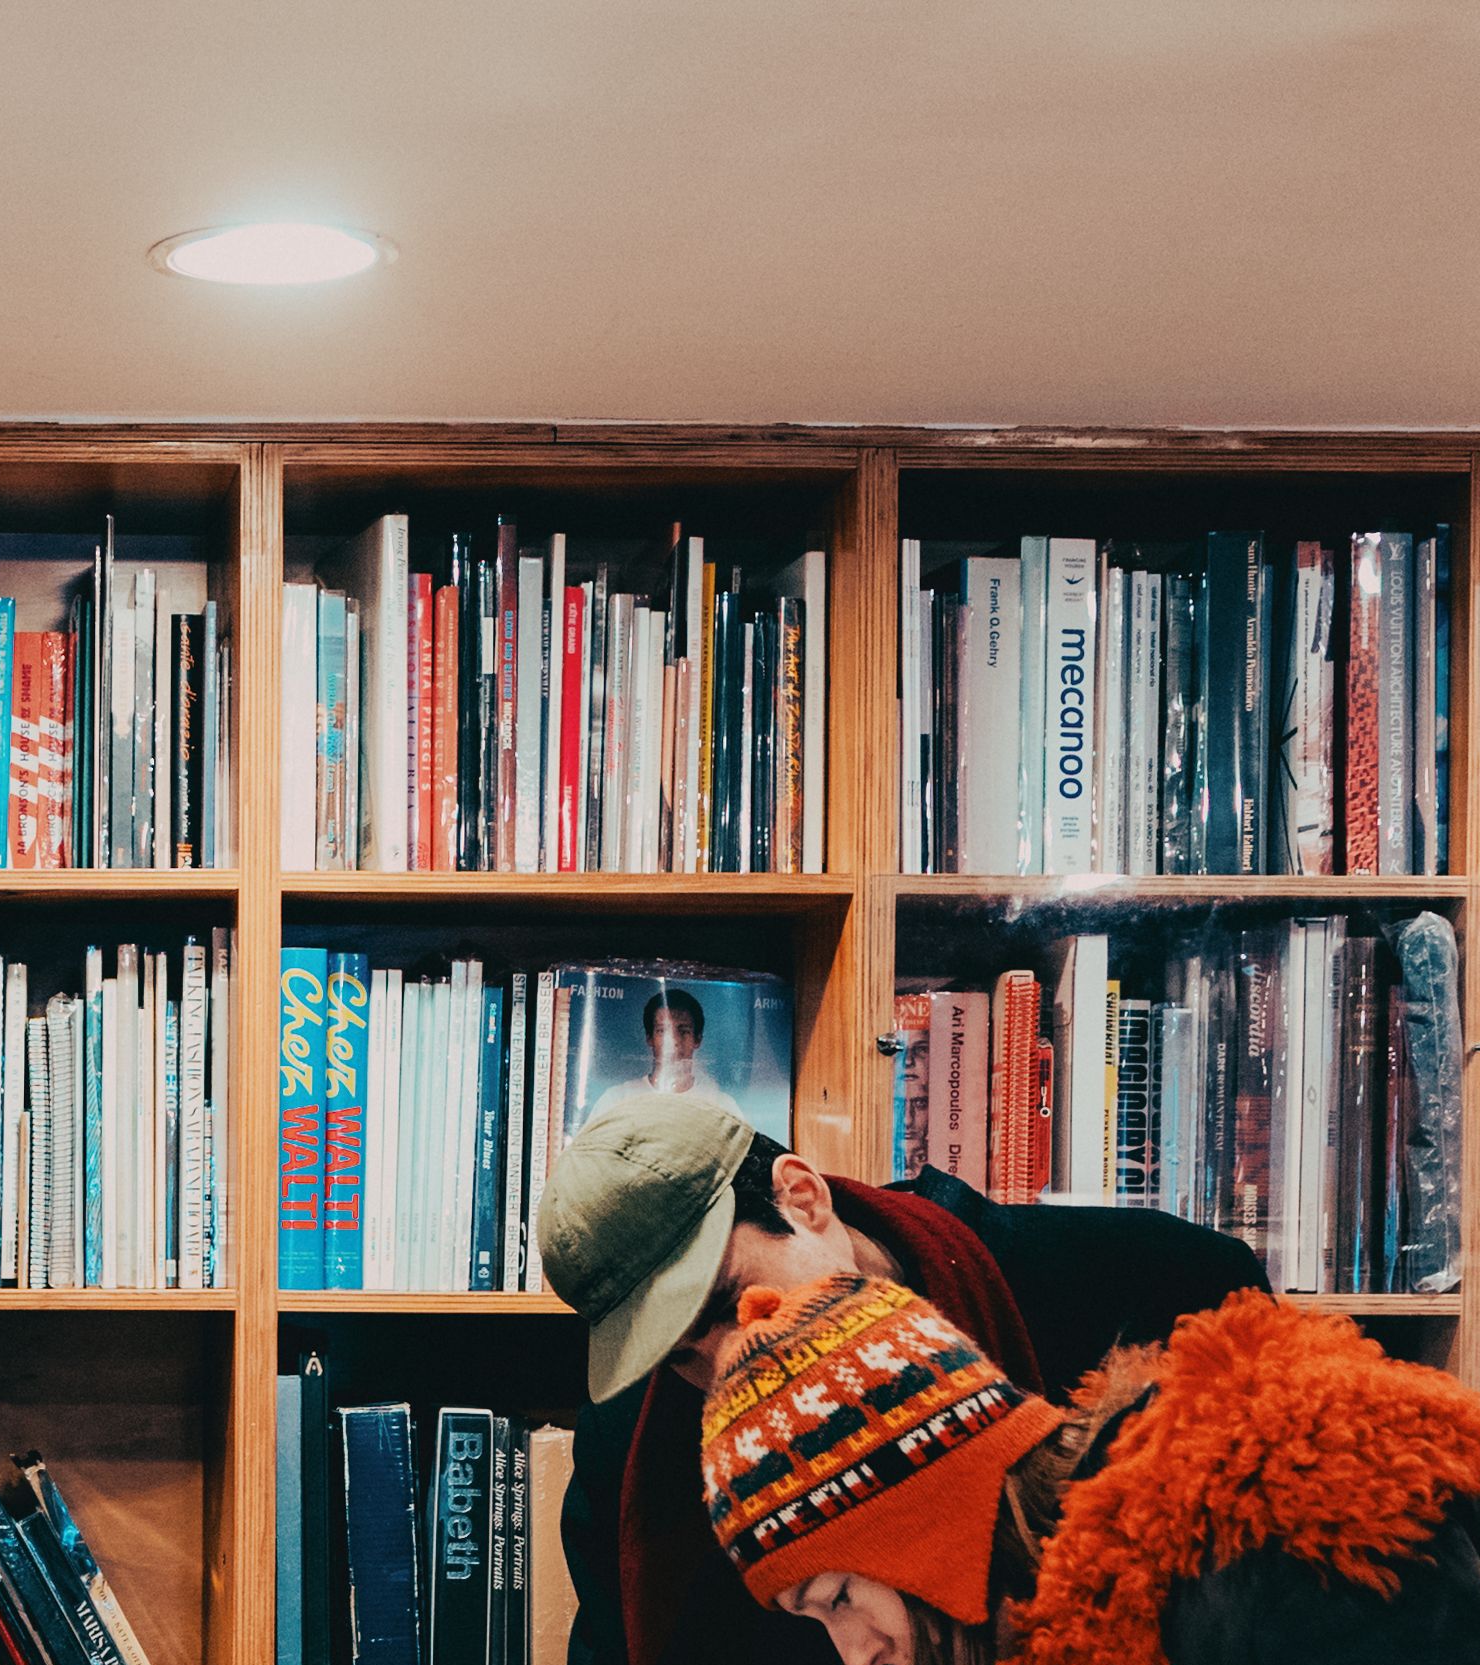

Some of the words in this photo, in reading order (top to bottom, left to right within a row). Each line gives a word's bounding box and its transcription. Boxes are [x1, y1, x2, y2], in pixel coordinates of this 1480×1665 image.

[567, 603, 576, 627] KATIE
[989, 578, 1001, 613] Frank
[566, 629, 576, 654] GRAND
[989, 617, 1000, 630] O.
[1245, 616, 1256, 657] Arnaldo
[421, 639, 432, 691] ANNA
[986, 632, 1000, 668] Gehry
[1245, 659, 1255, 712] Pomodoro
[1059, 629, 1086, 799] mecanoo
[421, 705, 432, 792] PIAGGI'S
[1243, 798, 1254, 831] Fabbri
[1242, 834, 1253, 871] Editori
[569, 984, 624, 1000] FASHION
[951, 1006, 964, 1027] Ari
[280, 968, 323, 1096] Chez
[326, 971, 367, 1098] Chez
[947, 1033, 965, 1130] Marcopoulos
[281, 1105, 319, 1231] WALTI
[323, 1106, 362, 1231] WALTI
[482, 1139, 493, 1170] Blues
[514, 1448, 524, 1478] Alice
[446, 1431, 483, 1580] Babeth
[512, 1482, 524, 1531] Springs:
[513, 1535, 524, 1590] Portraits
[72, 1602, 117, 1658] MARISA
